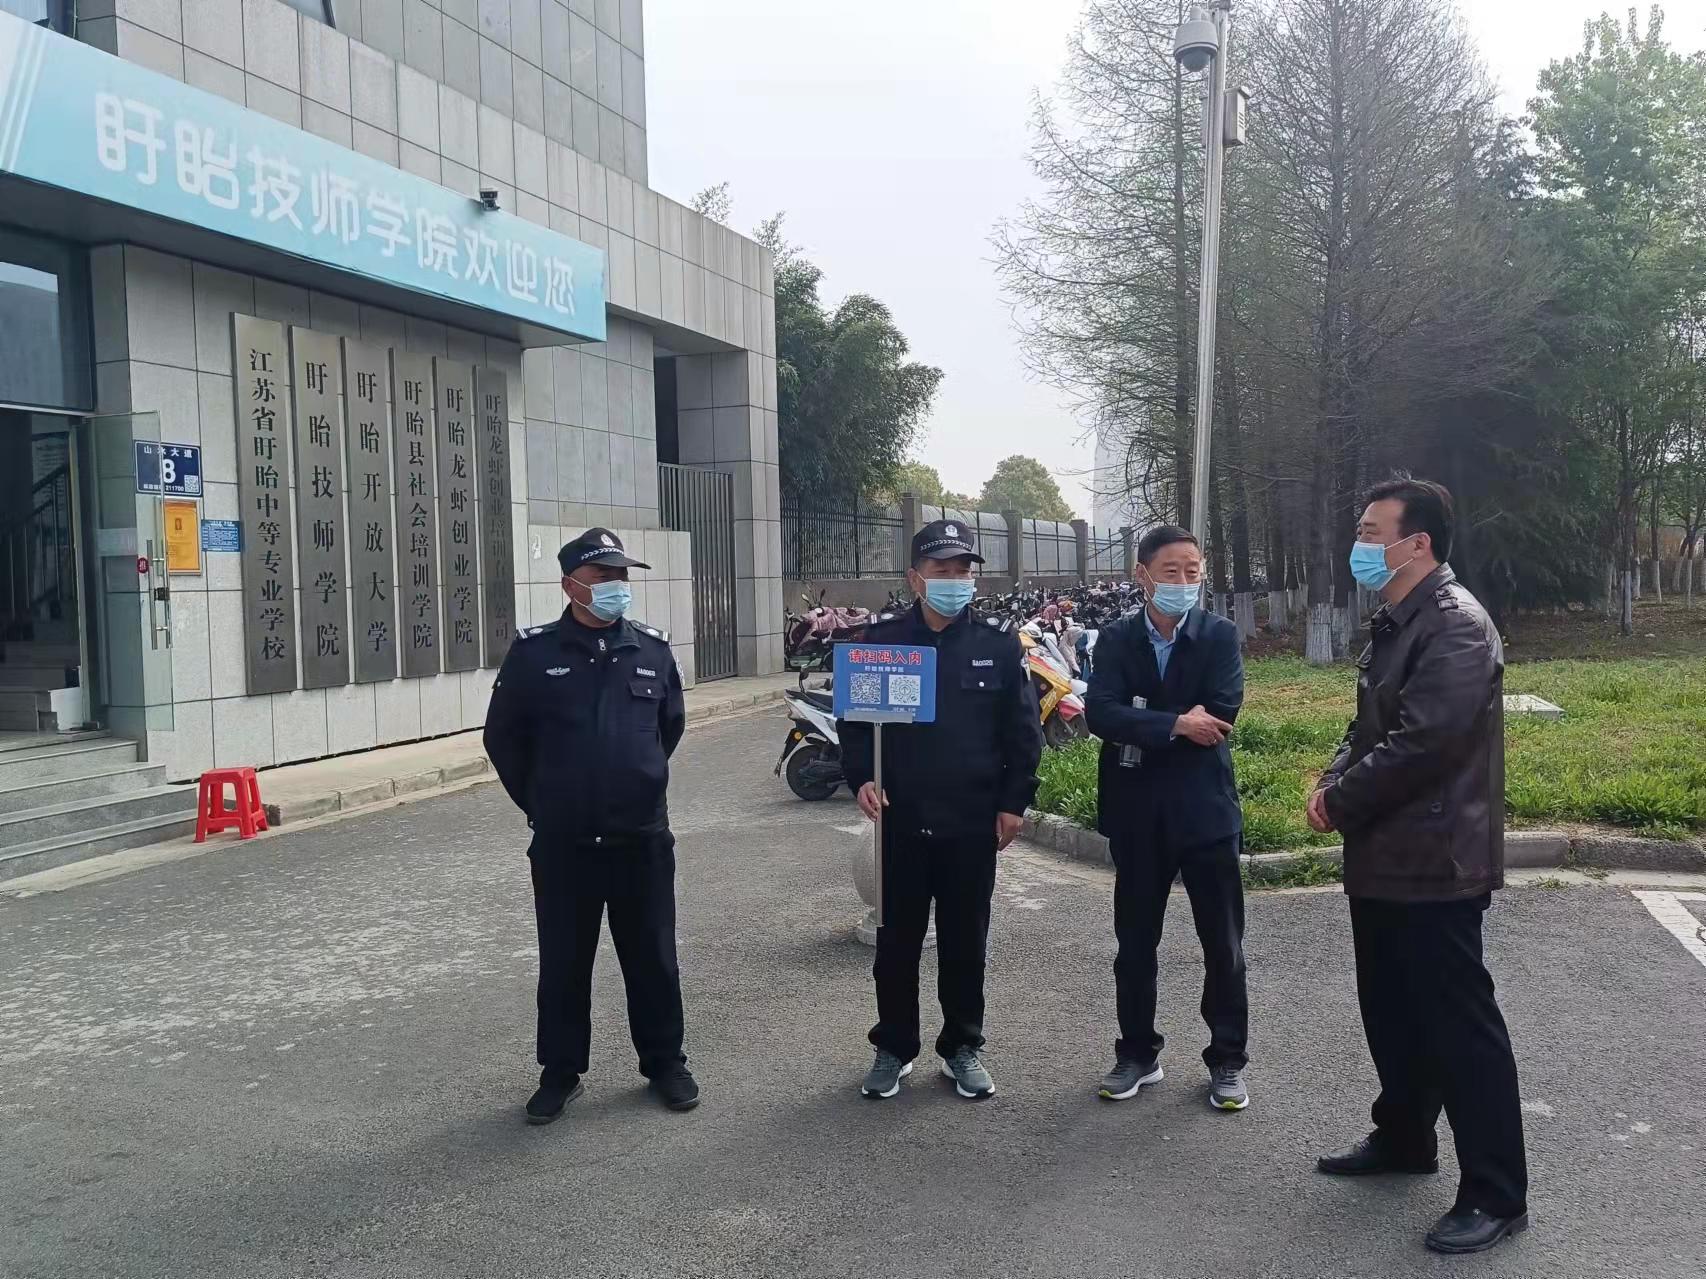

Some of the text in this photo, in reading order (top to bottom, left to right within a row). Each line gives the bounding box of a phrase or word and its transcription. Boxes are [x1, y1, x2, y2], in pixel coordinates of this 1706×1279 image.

[95, 92, 577, 318] 盱眙技师学院欢迎您
[160, 458, 176, 483] 8
[250, 348, 286, 660] 江苏省盱眙中等专业学校
[305, 361, 340, 658] 盱眙技师学院
[356, 371, 389, 653] 盱眙开放大学
[404, 379, 432, 650] 盱眙县社会培训学院
[447, 387, 473, 646] 盱眙龙虾创业学院
[848, 648, 922, 665] 请扫码入内
